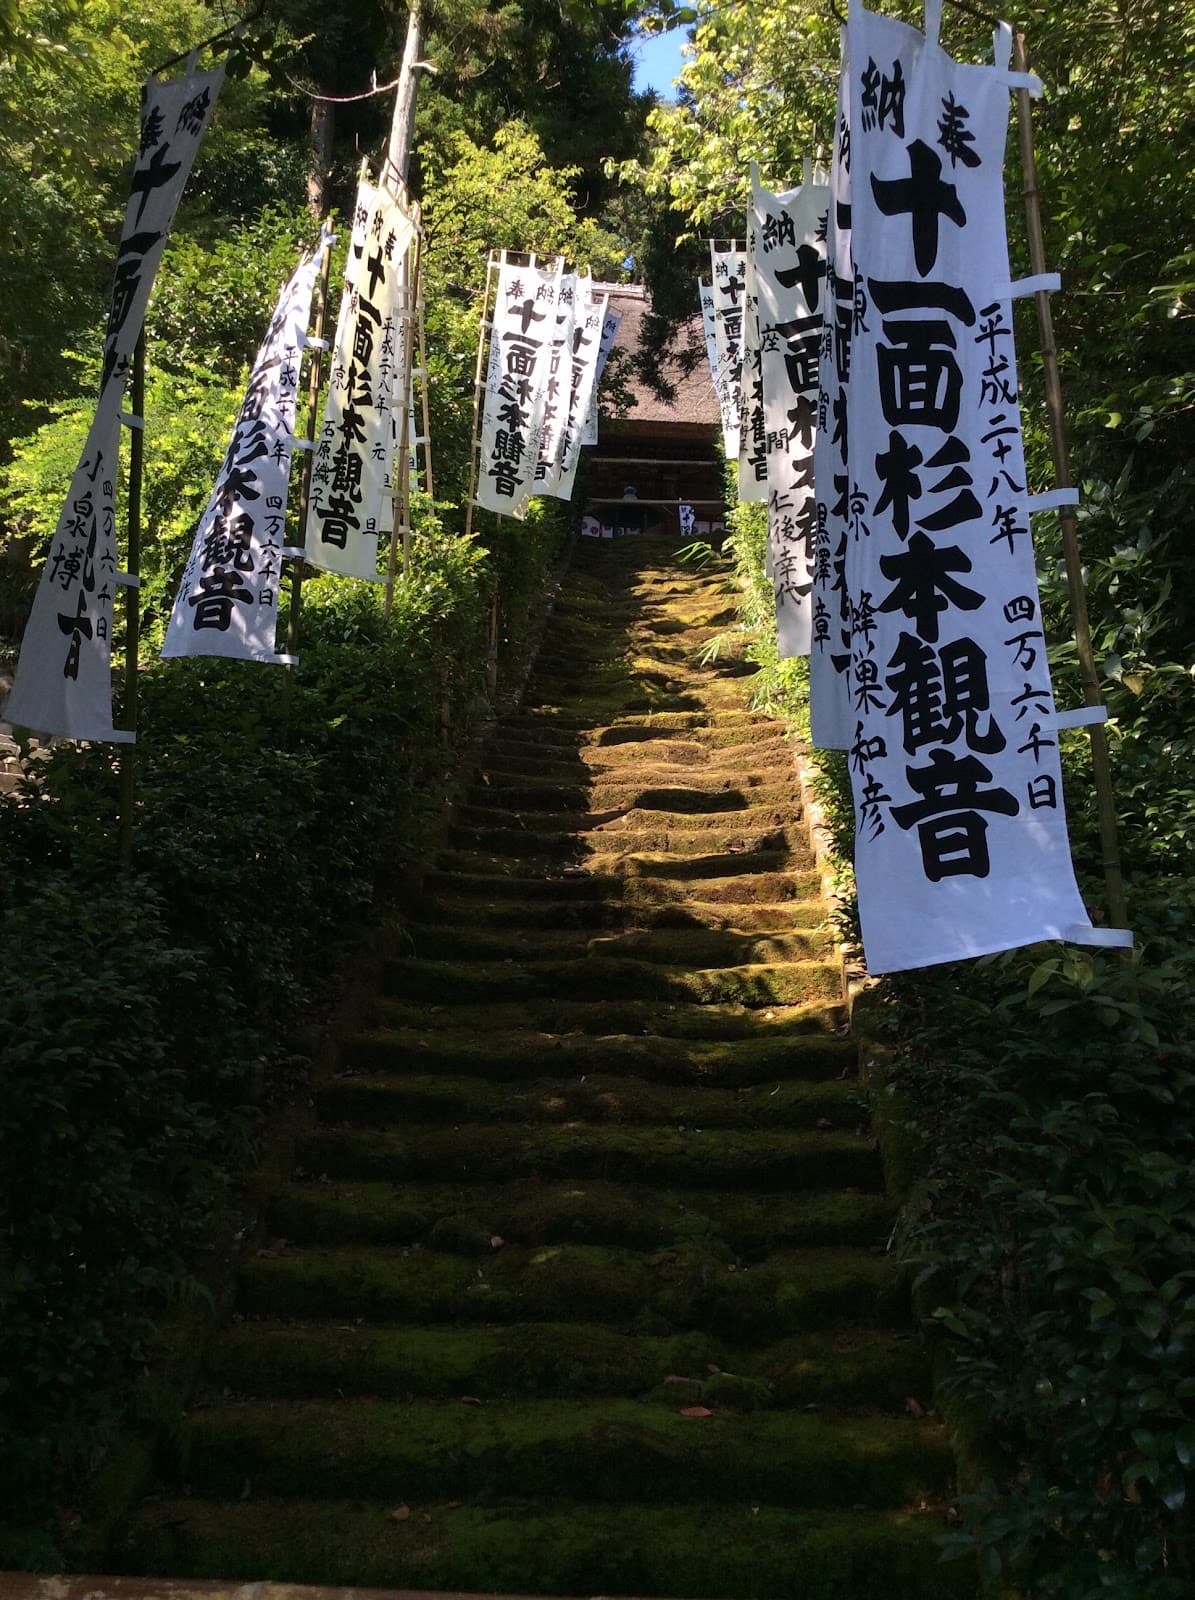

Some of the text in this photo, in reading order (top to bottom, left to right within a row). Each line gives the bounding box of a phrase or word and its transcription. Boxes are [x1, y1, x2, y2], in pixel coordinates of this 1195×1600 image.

[258, 346, 298, 607] 平成二十八年 四万六千日
[317, 246, 385, 549] 十一面杉本観音
[374, 317, 396, 417] 平成二十八年
[974, 304, 1028, 554] 平成二十八年
[97, 480, 116, 641] 四万六千日
[868, 139, 1019, 881] 十一面杉本観音
[1003, 595, 1057, 810] 四万六千日
